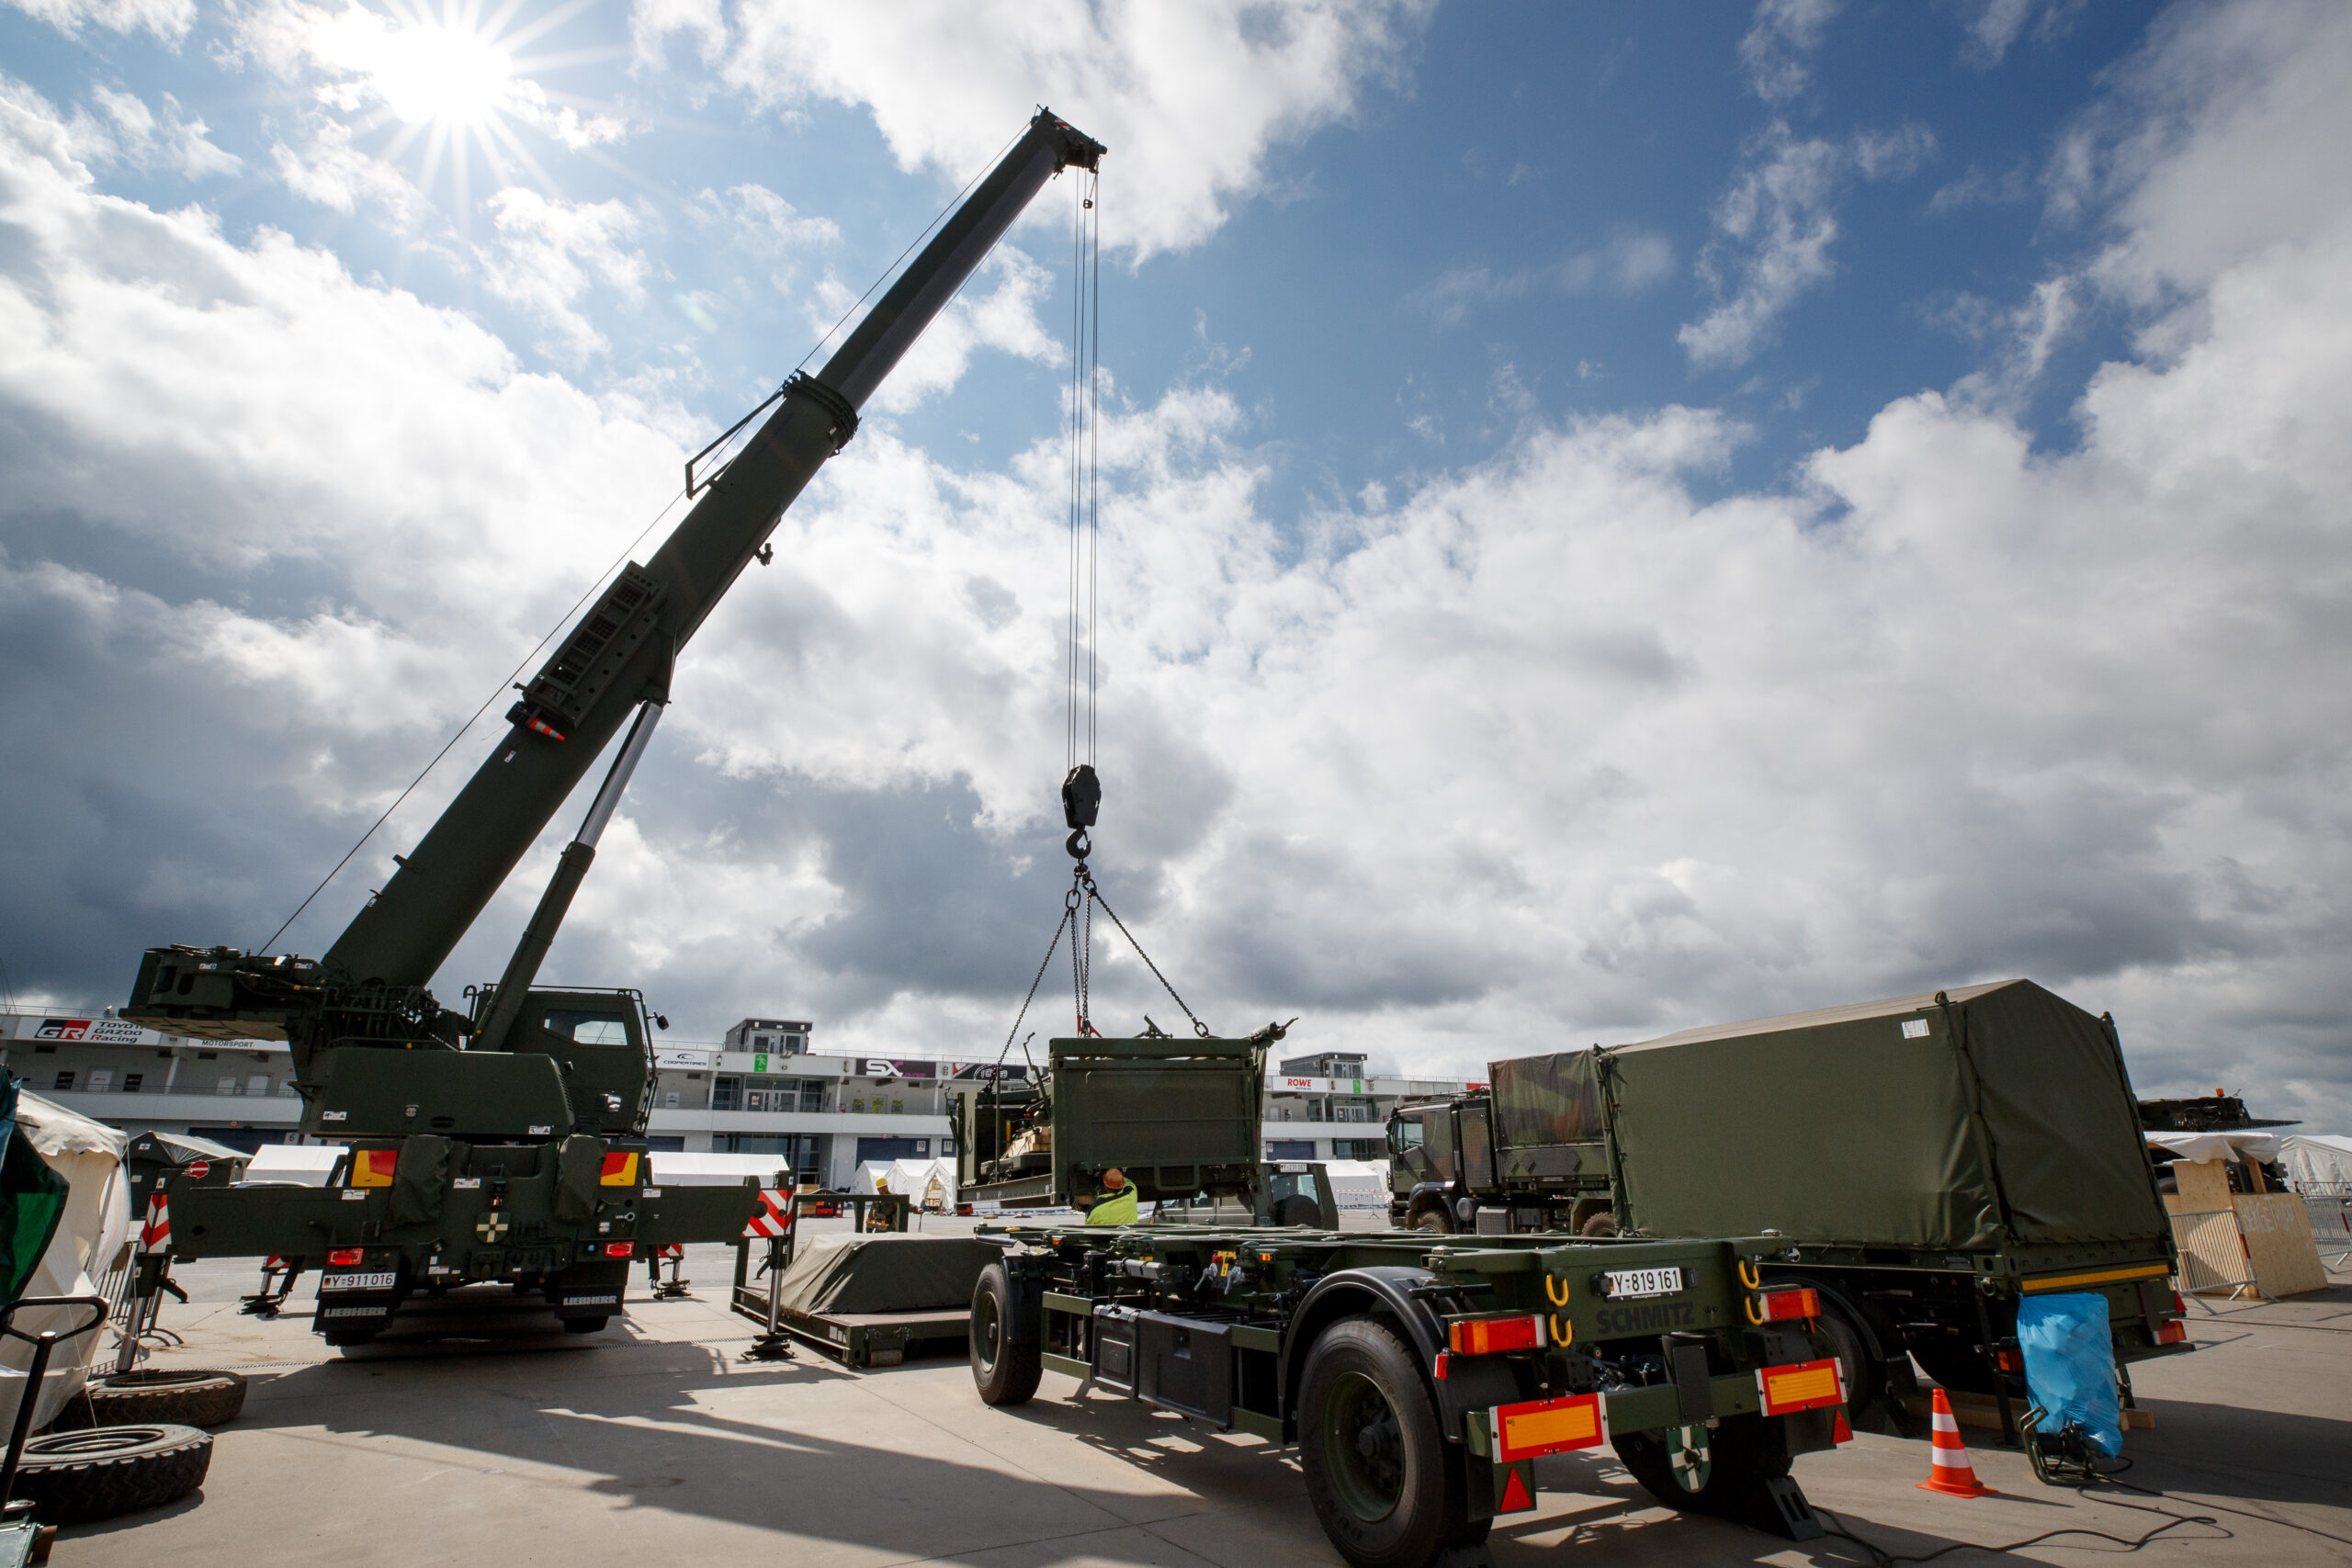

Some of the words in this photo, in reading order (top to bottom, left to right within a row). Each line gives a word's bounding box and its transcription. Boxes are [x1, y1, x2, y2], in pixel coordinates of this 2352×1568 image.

[94, 1028, 142, 1036] GAZOO
[90, 1034, 138, 1044] Racing
[201, 1039, 254, 1048] MOTORSPORT
[1287, 1078, 1312, 1088] ROWE
[1657, 1269, 1679, 1290] 161
[563, 1295, 617, 1305] LIEBHERR
[323, 1306, 388, 1317] LIEBHERR
[1596, 1303, 1696, 1334] SCHMITZ
